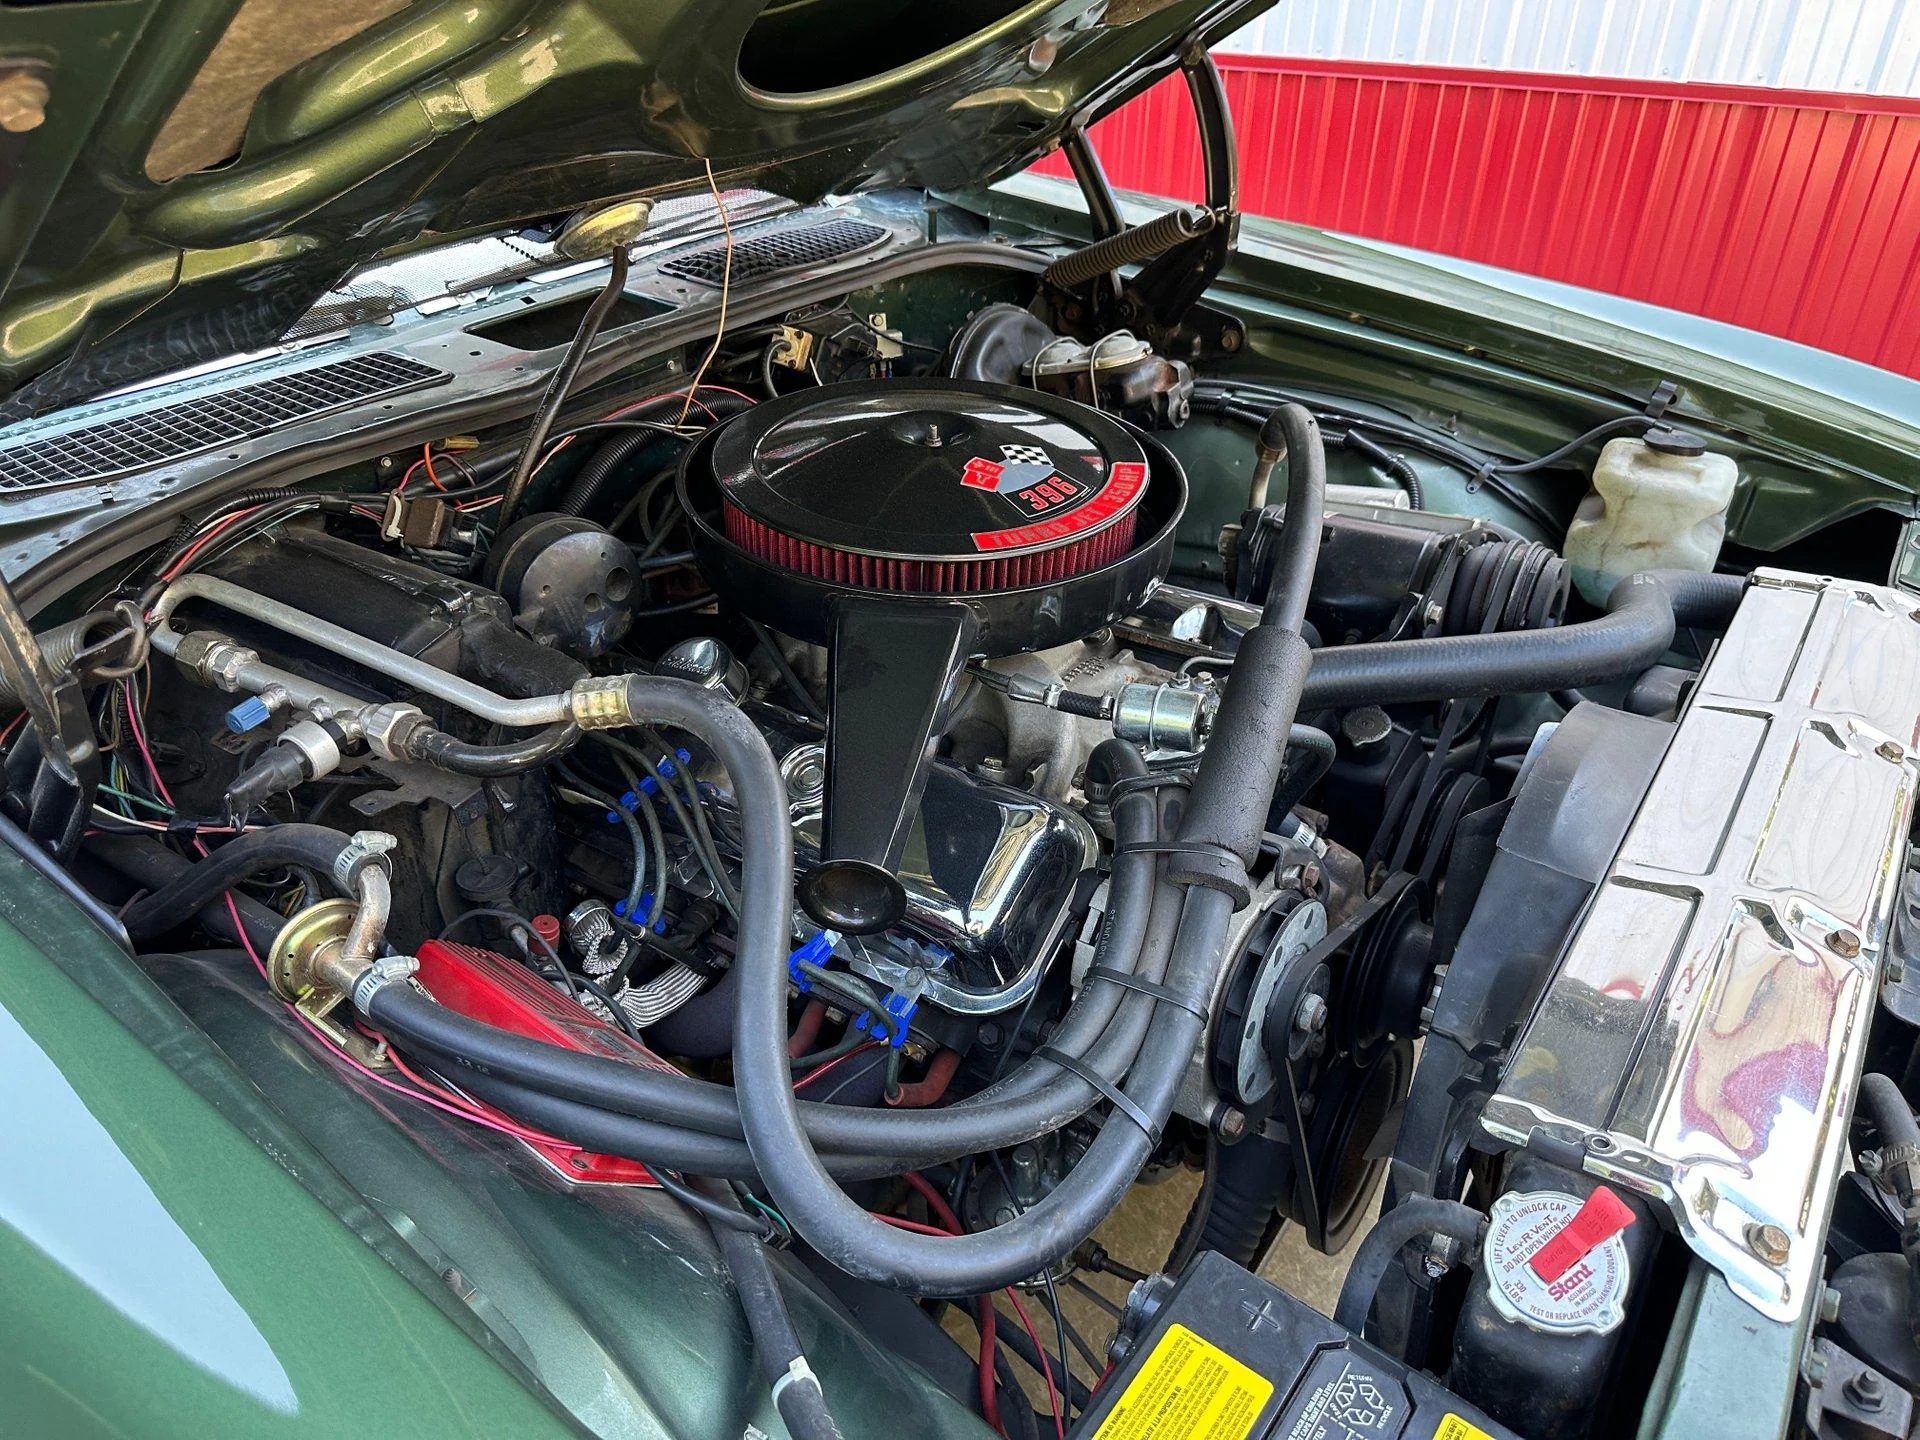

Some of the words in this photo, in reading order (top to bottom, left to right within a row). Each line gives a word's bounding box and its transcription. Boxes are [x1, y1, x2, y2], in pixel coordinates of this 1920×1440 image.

[1018, 476, 1078, 511] 396
[1516, 1203, 1548, 1218] UNLOCK
[1550, 1202, 1567, 1213] CAP
[1506, 1214, 1518, 1225] TO
[1495, 1224, 1511, 1247] LEVER
[1503, 1261, 1514, 1273] DO
[1512, 1251, 1527, 1266] NOT
[1525, 1239, 1544, 1255] OPEN
[1540, 1223, 1562, 1242] WHEN
[1560, 1213, 1573, 1228] HOT
[1494, 1248, 1503, 1264] LIFT
[1502, 1281, 1512, 1290] 16
[1508, 1288, 1523, 1303] LBS
[1514, 1280, 1527, 1293] 330
[1548, 1262, 1593, 1302] Stant
[1568, 1281, 1593, 1302] ASSEMBLED
[1529, 1304, 1544, 1318] TEST
[1545, 1311, 1554, 1320] OR
[1555, 1310, 1582, 1321] REPLACE
[1581, 1301, 1599, 1316] WHEN
[1596, 1274, 1615, 1304] CHANGING
[1579, 1287, 1597, 1303] MEXICO
